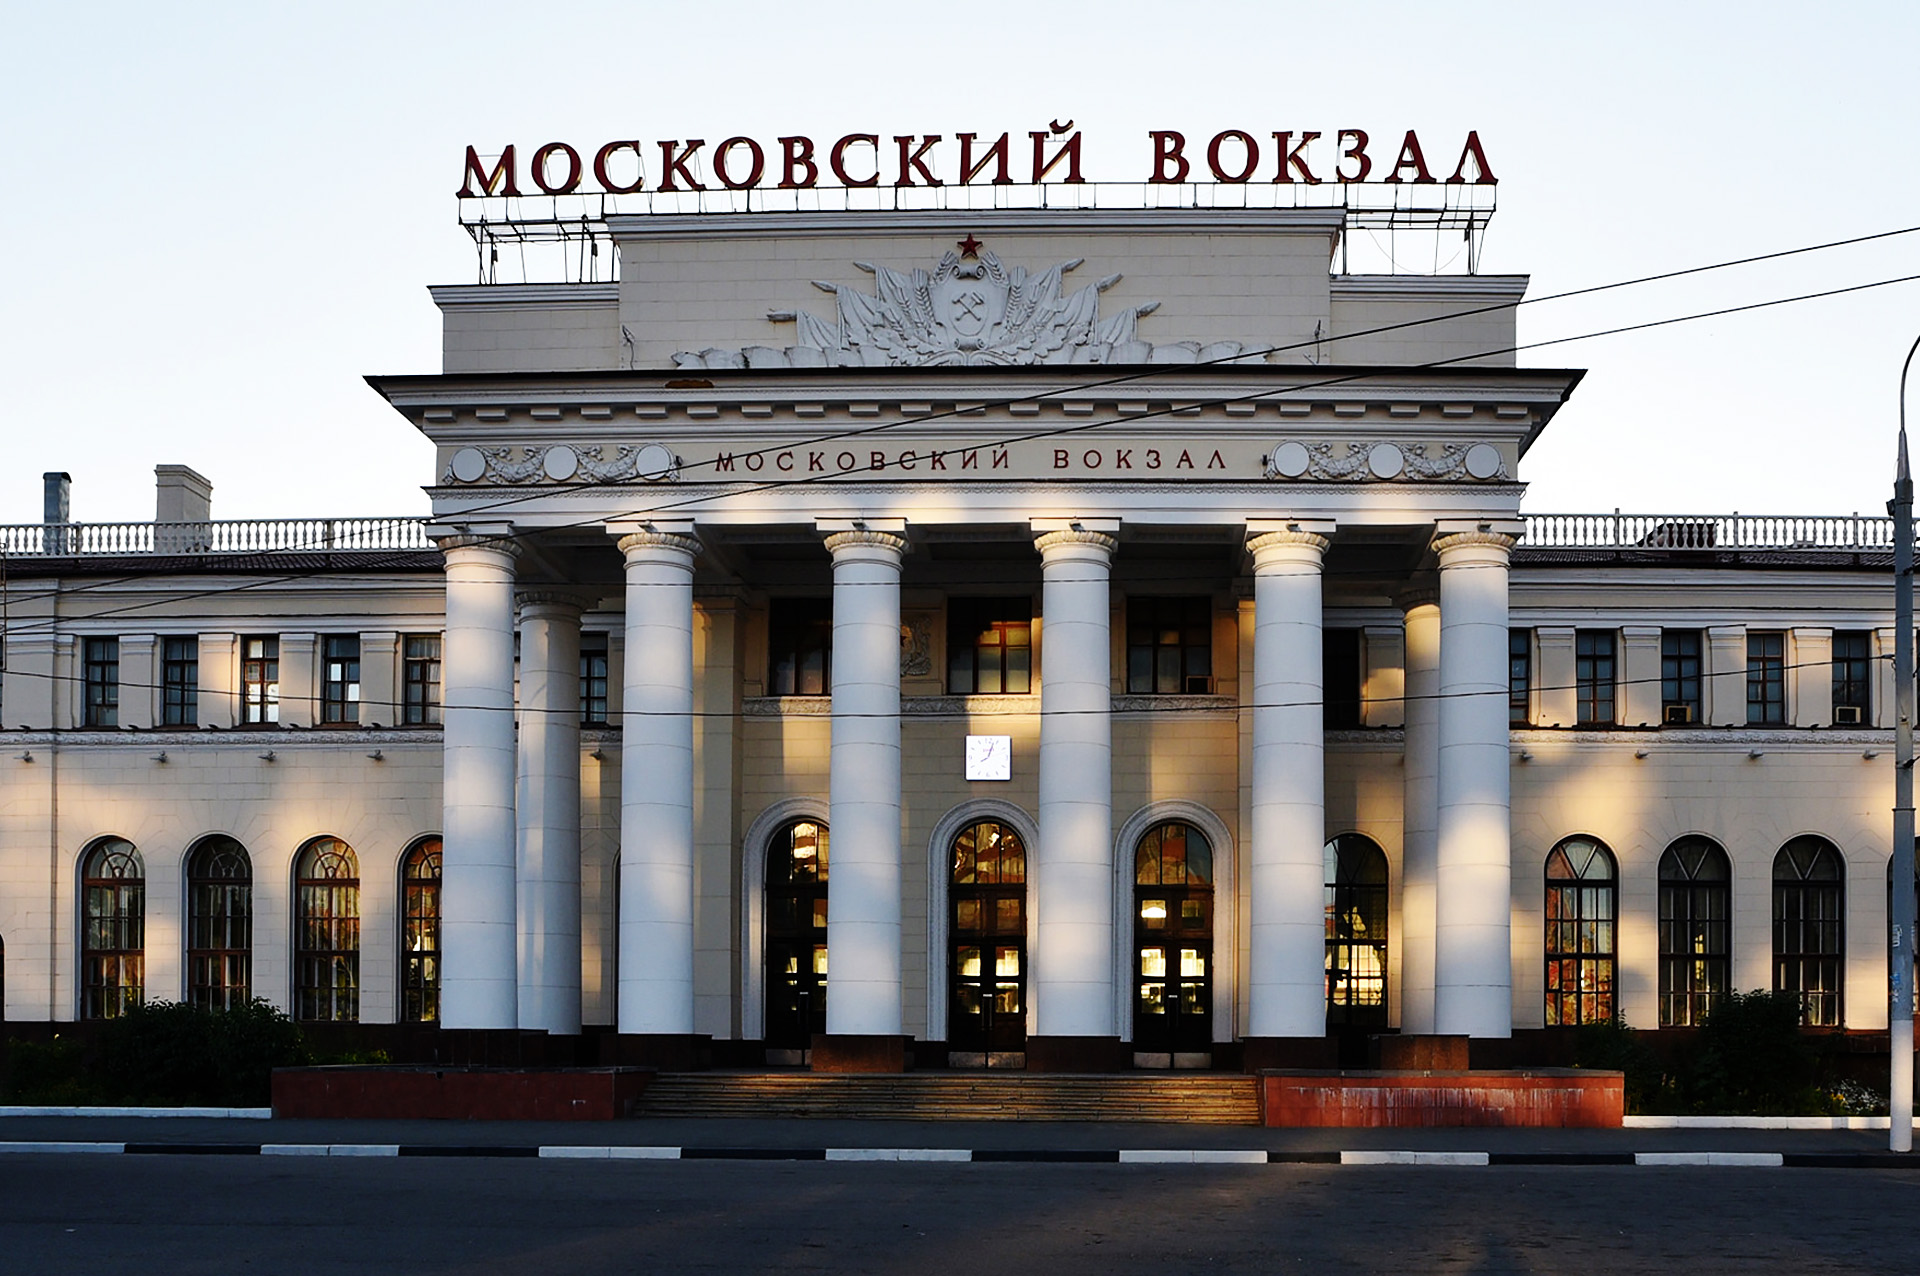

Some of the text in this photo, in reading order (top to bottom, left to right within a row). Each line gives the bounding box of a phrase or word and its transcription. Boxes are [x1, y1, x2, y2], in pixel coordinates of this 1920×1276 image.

[457, 119, 1498, 197] МОСКОВСКИЙ ВОКЗАЛ
[715, 444, 1226, 472] МОСКОВСКИЙ ВОКЗАЛ
